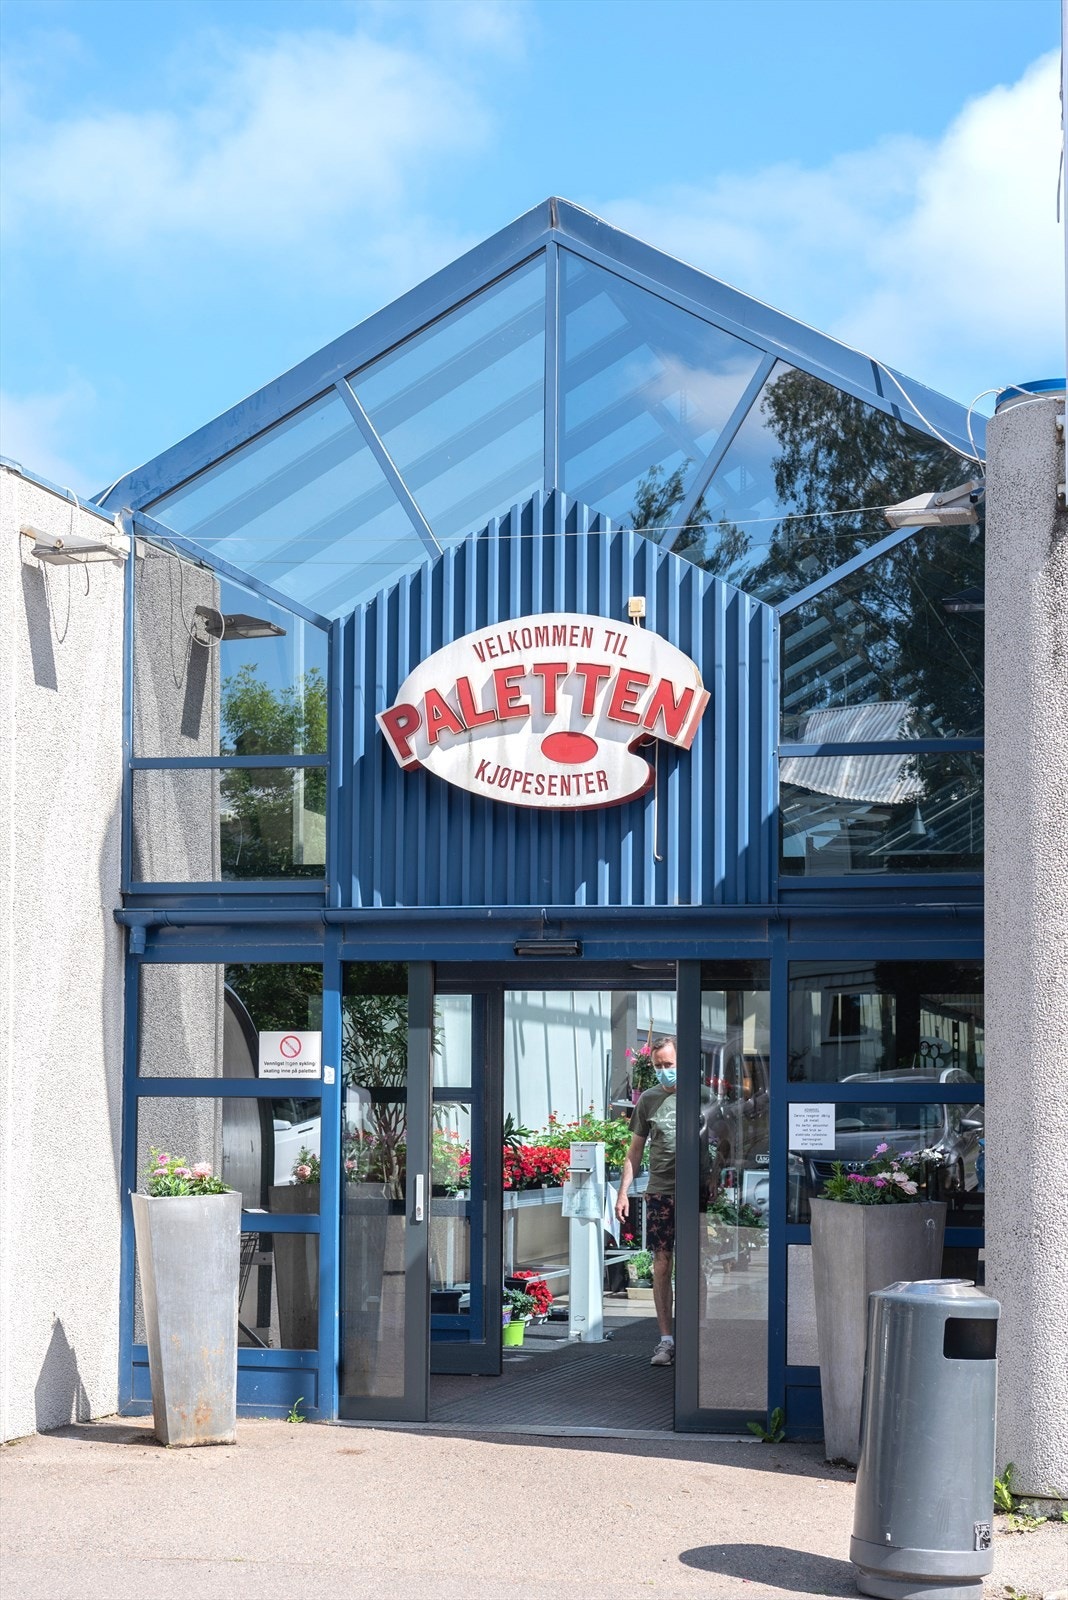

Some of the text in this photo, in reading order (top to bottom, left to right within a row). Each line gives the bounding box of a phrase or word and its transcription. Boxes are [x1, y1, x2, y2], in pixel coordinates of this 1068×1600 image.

[472, 625, 629, 663] VELKOMMEN TIL
[381, 662, 695, 760] PALETTEN
[474, 759, 609, 796] KJØPESENTER
